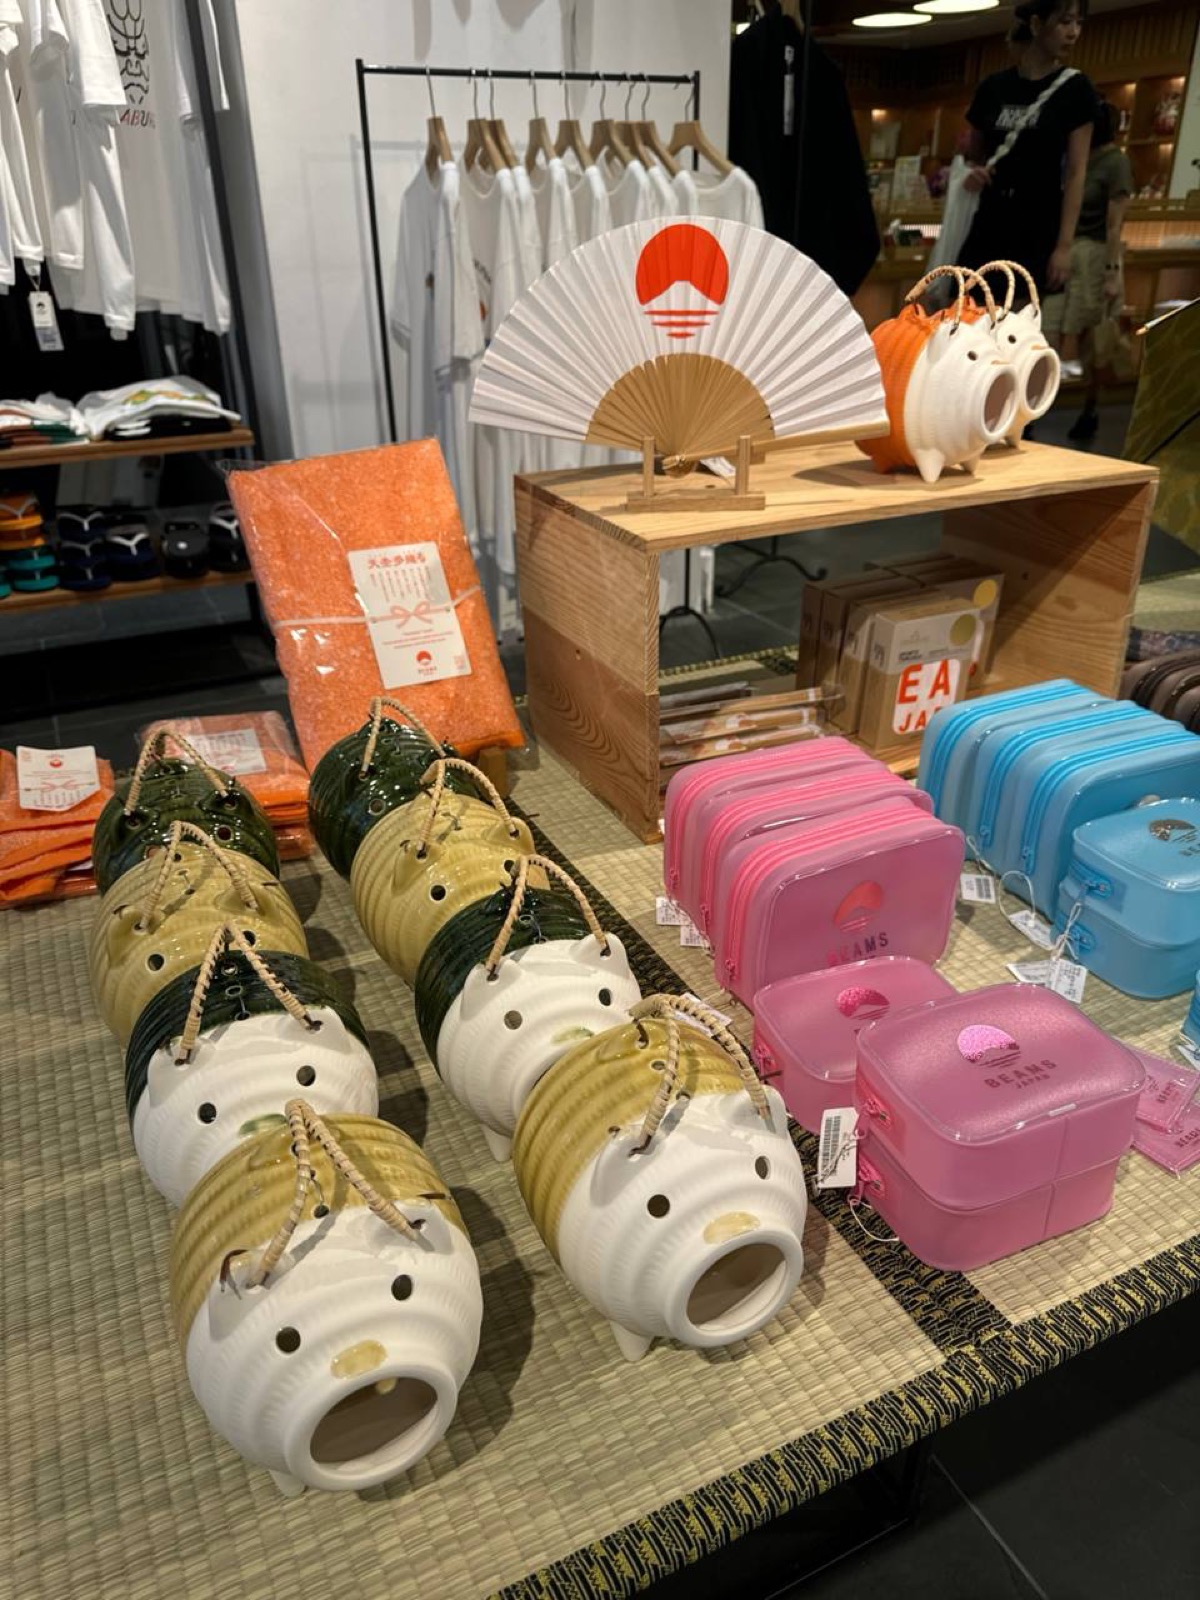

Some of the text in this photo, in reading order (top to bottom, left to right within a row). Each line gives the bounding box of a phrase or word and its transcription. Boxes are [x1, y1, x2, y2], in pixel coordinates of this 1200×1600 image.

[898, 706, 942, 732] JA
[984, 1060, 1057, 1088] BEAMS
[1015, 1074, 1051, 1090] JAPAN
